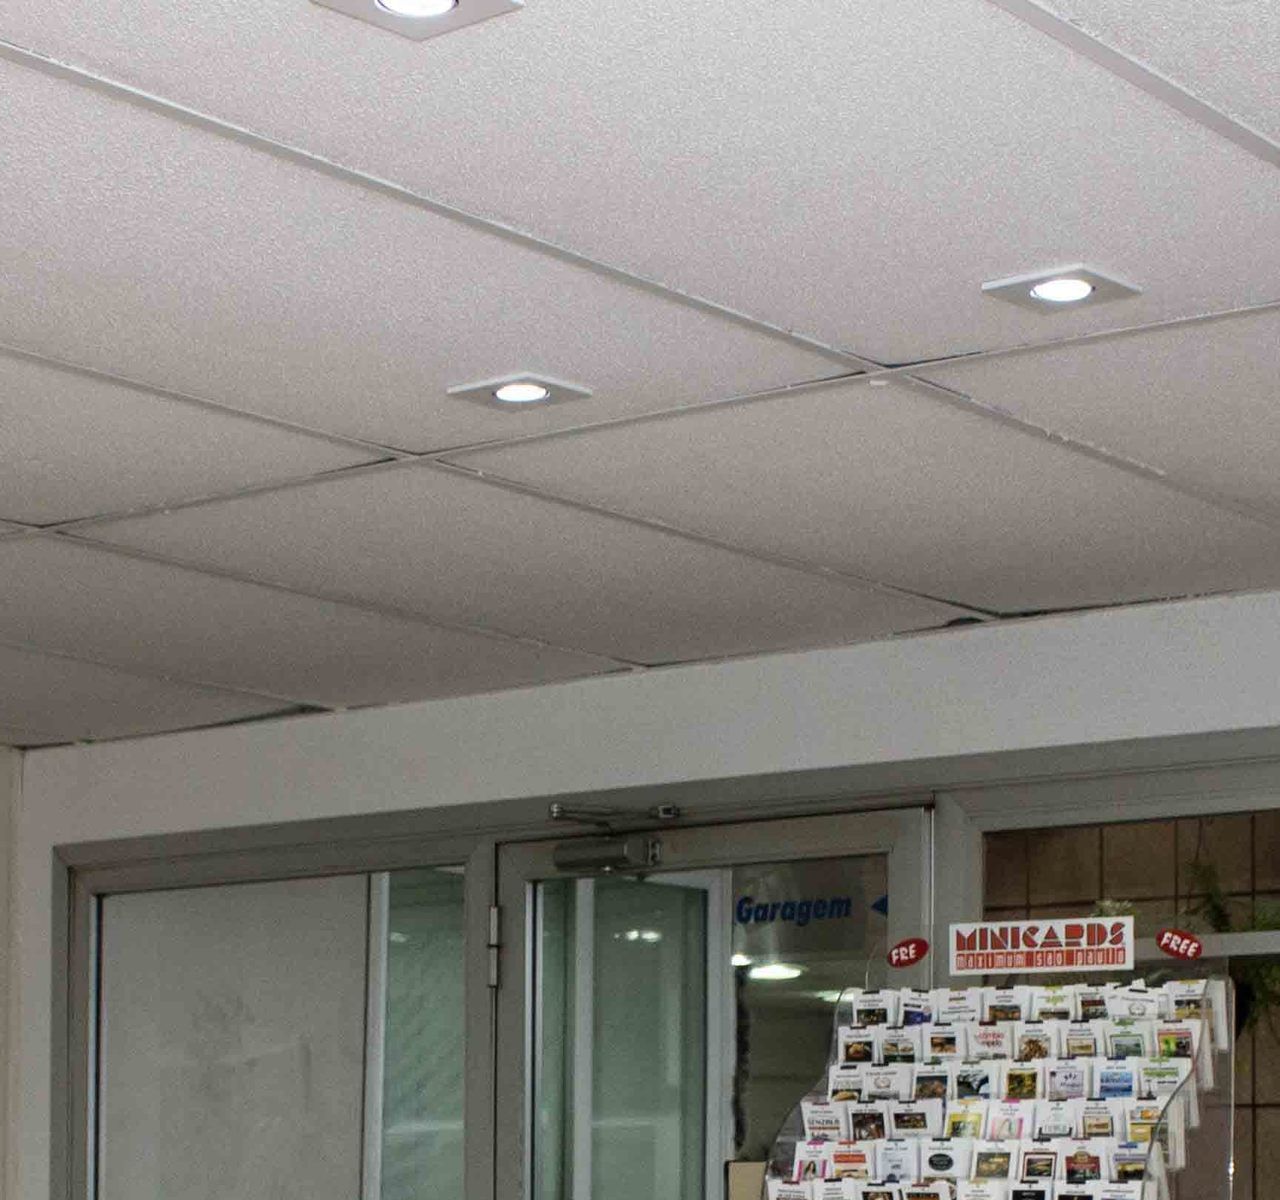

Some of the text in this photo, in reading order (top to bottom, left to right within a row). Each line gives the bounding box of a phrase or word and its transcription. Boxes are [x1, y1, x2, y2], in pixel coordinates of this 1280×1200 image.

[735, 896, 852, 927] Garagem
[955, 921, 1126, 951] MINICARDS
[1160, 931, 1199, 957] FREE
[891, 943, 917, 964] FRE
[956, 952, 1026, 970] maximum
[1074, 948, 1126, 966] paulo
